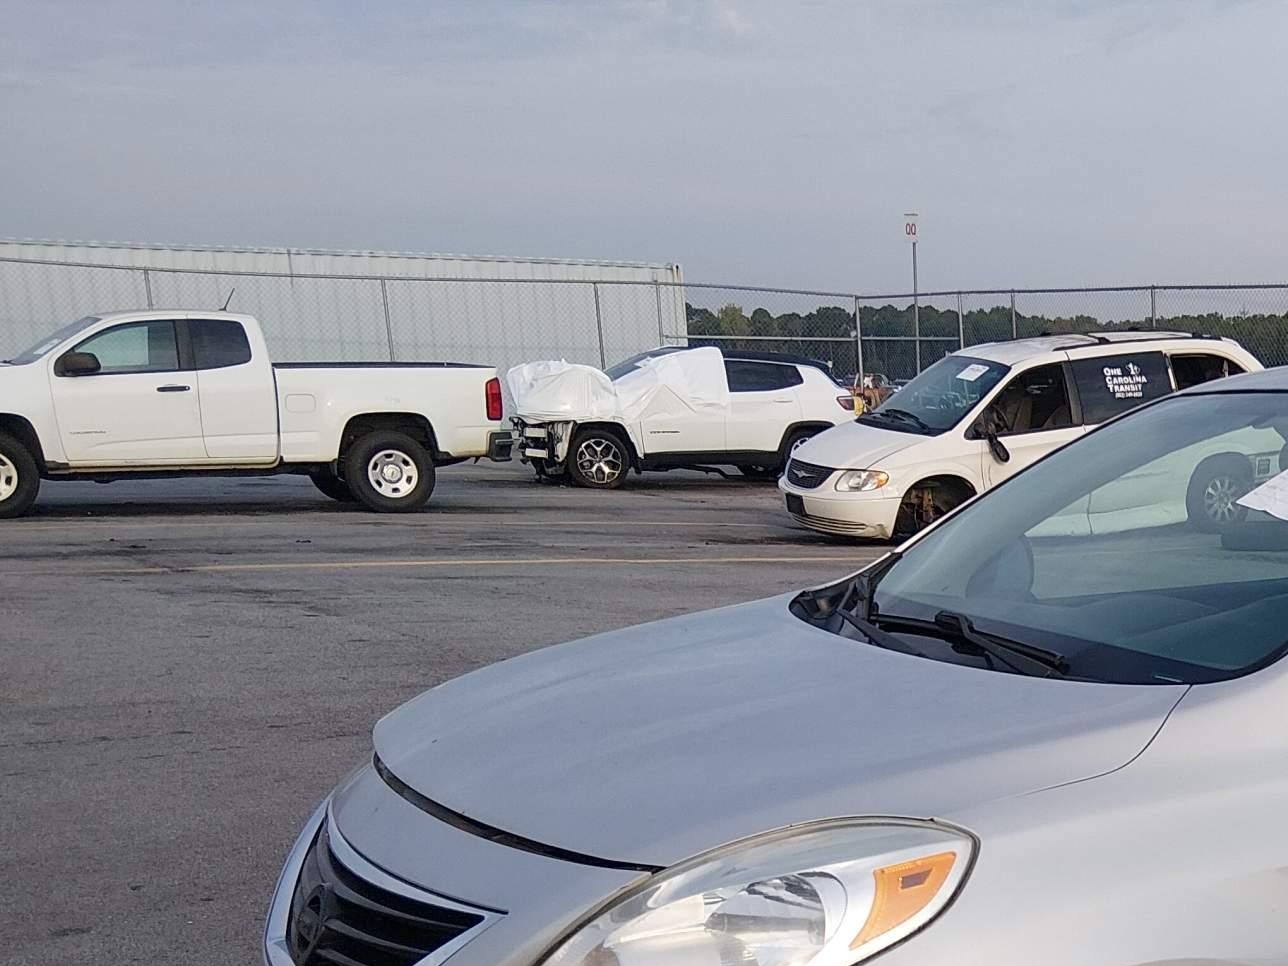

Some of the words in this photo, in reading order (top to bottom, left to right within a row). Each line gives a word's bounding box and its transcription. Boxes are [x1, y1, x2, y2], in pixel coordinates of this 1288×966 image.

[1103, 367, 1122, 376] ONE
[1105, 375, 1148, 384] CAROLINA
[1107, 383, 1142, 393] TRANSIT
